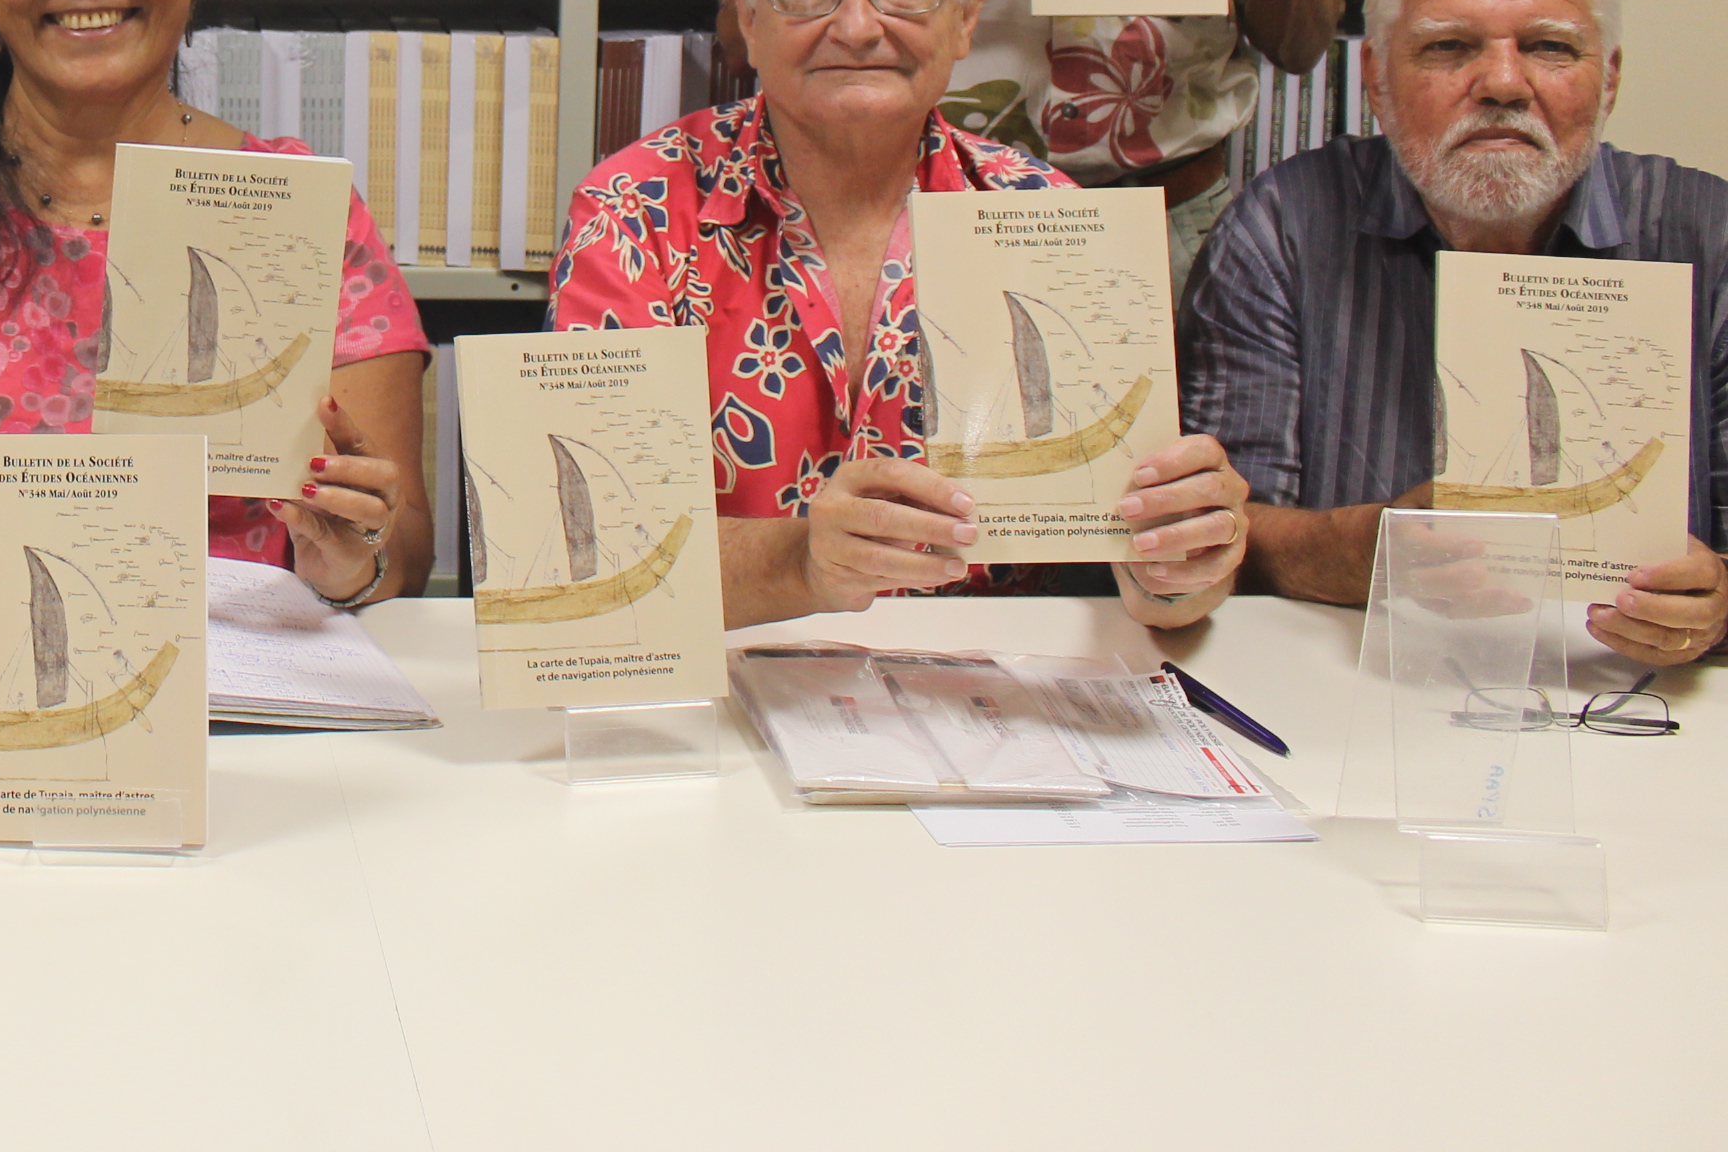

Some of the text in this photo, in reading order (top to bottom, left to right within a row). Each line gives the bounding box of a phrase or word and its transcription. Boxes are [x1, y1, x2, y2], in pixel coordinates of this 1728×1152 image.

[175, 168, 288, 186] BULLETIN DE LA SOCIÉTÉ
[170, 180, 291, 199] DES ÉTUDES OCÉANIENNES
[187, 198, 272, 211] N°348 Mai/Août 2019
[978, 207, 1100, 220] BULLETIN DE LA SOCIÉTÉ
[974, 220, 1105, 234] DES ÉTUDES OCÉANIENNES
[994, 238, 1087, 248] N°348 Mai/Août 2019
[1503, 272, 1624, 288] BULLETIN DE LA SOCIÉTÉ
[1498, 284, 1628, 302] DES ÉTUDES OCÉANIENNES
[1517, 301, 1609, 314] N°348 Mai/Août 2019
[523, 348, 641, 363] BULLETIN DE LA SOCIÉTÉ
[520, 363, 647, 378] DES ÉTUDES OCÉANIENNES
[539, 378, 629, 391] N°348 Mai/Août 2019
[3, 456, 134, 467] BULLETIN DE LA SOCIÉTÉ
[215, 452, 280, 463] maître d'astres
[21, 468, 62, 483] ÉTUDES
[66, 472, 138, 483] OCÉANIENNES
[212, 464, 271, 475] polynésienne
[18, 489, 118, 498] N°348 Mai/Août 2019
[978, 513, 1100, 524] La carte de Tupaia, maître
[988, 526, 1131, 538] et de navigation polynésienne
[1568, 559, 1599, 568] maître
[527, 653, 681, 668] La carte de Tupaia, maître d'astres
[536, 667, 674, 682] et de navigation polynésienne
[24, 789, 36, 798] de
[39, 790, 75, 801] Tupaia,
[79, 790, 112, 799] maître
[115, 790, 155, 799] d'astres
[3, 805, 15, 813] de
[77, 805, 145, 817] polynésienne
